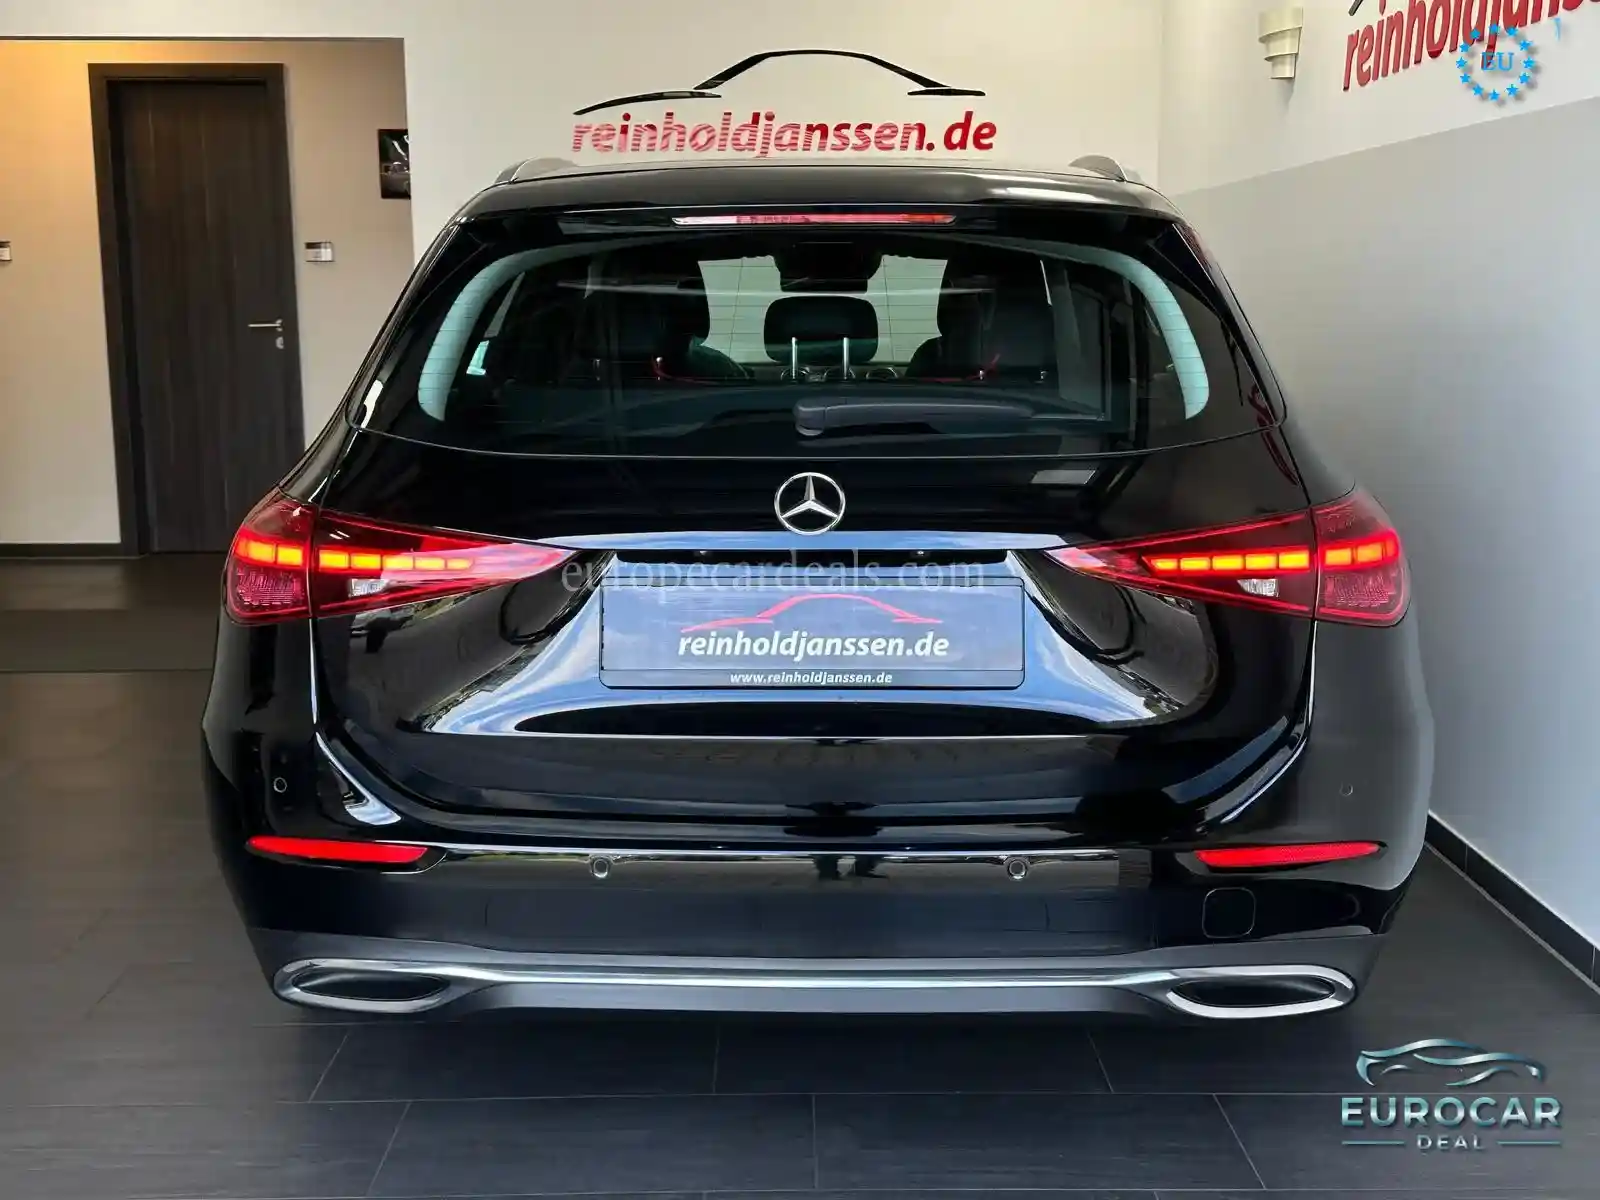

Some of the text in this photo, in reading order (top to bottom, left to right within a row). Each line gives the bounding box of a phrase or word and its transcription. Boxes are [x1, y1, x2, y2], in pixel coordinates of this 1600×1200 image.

[572, 111, 997, 158] reinholdjanssen.de
[678, 630, 949, 662] reinholdjanssen.de
[730, 671, 893, 686] www.reinholdjanssen.de
